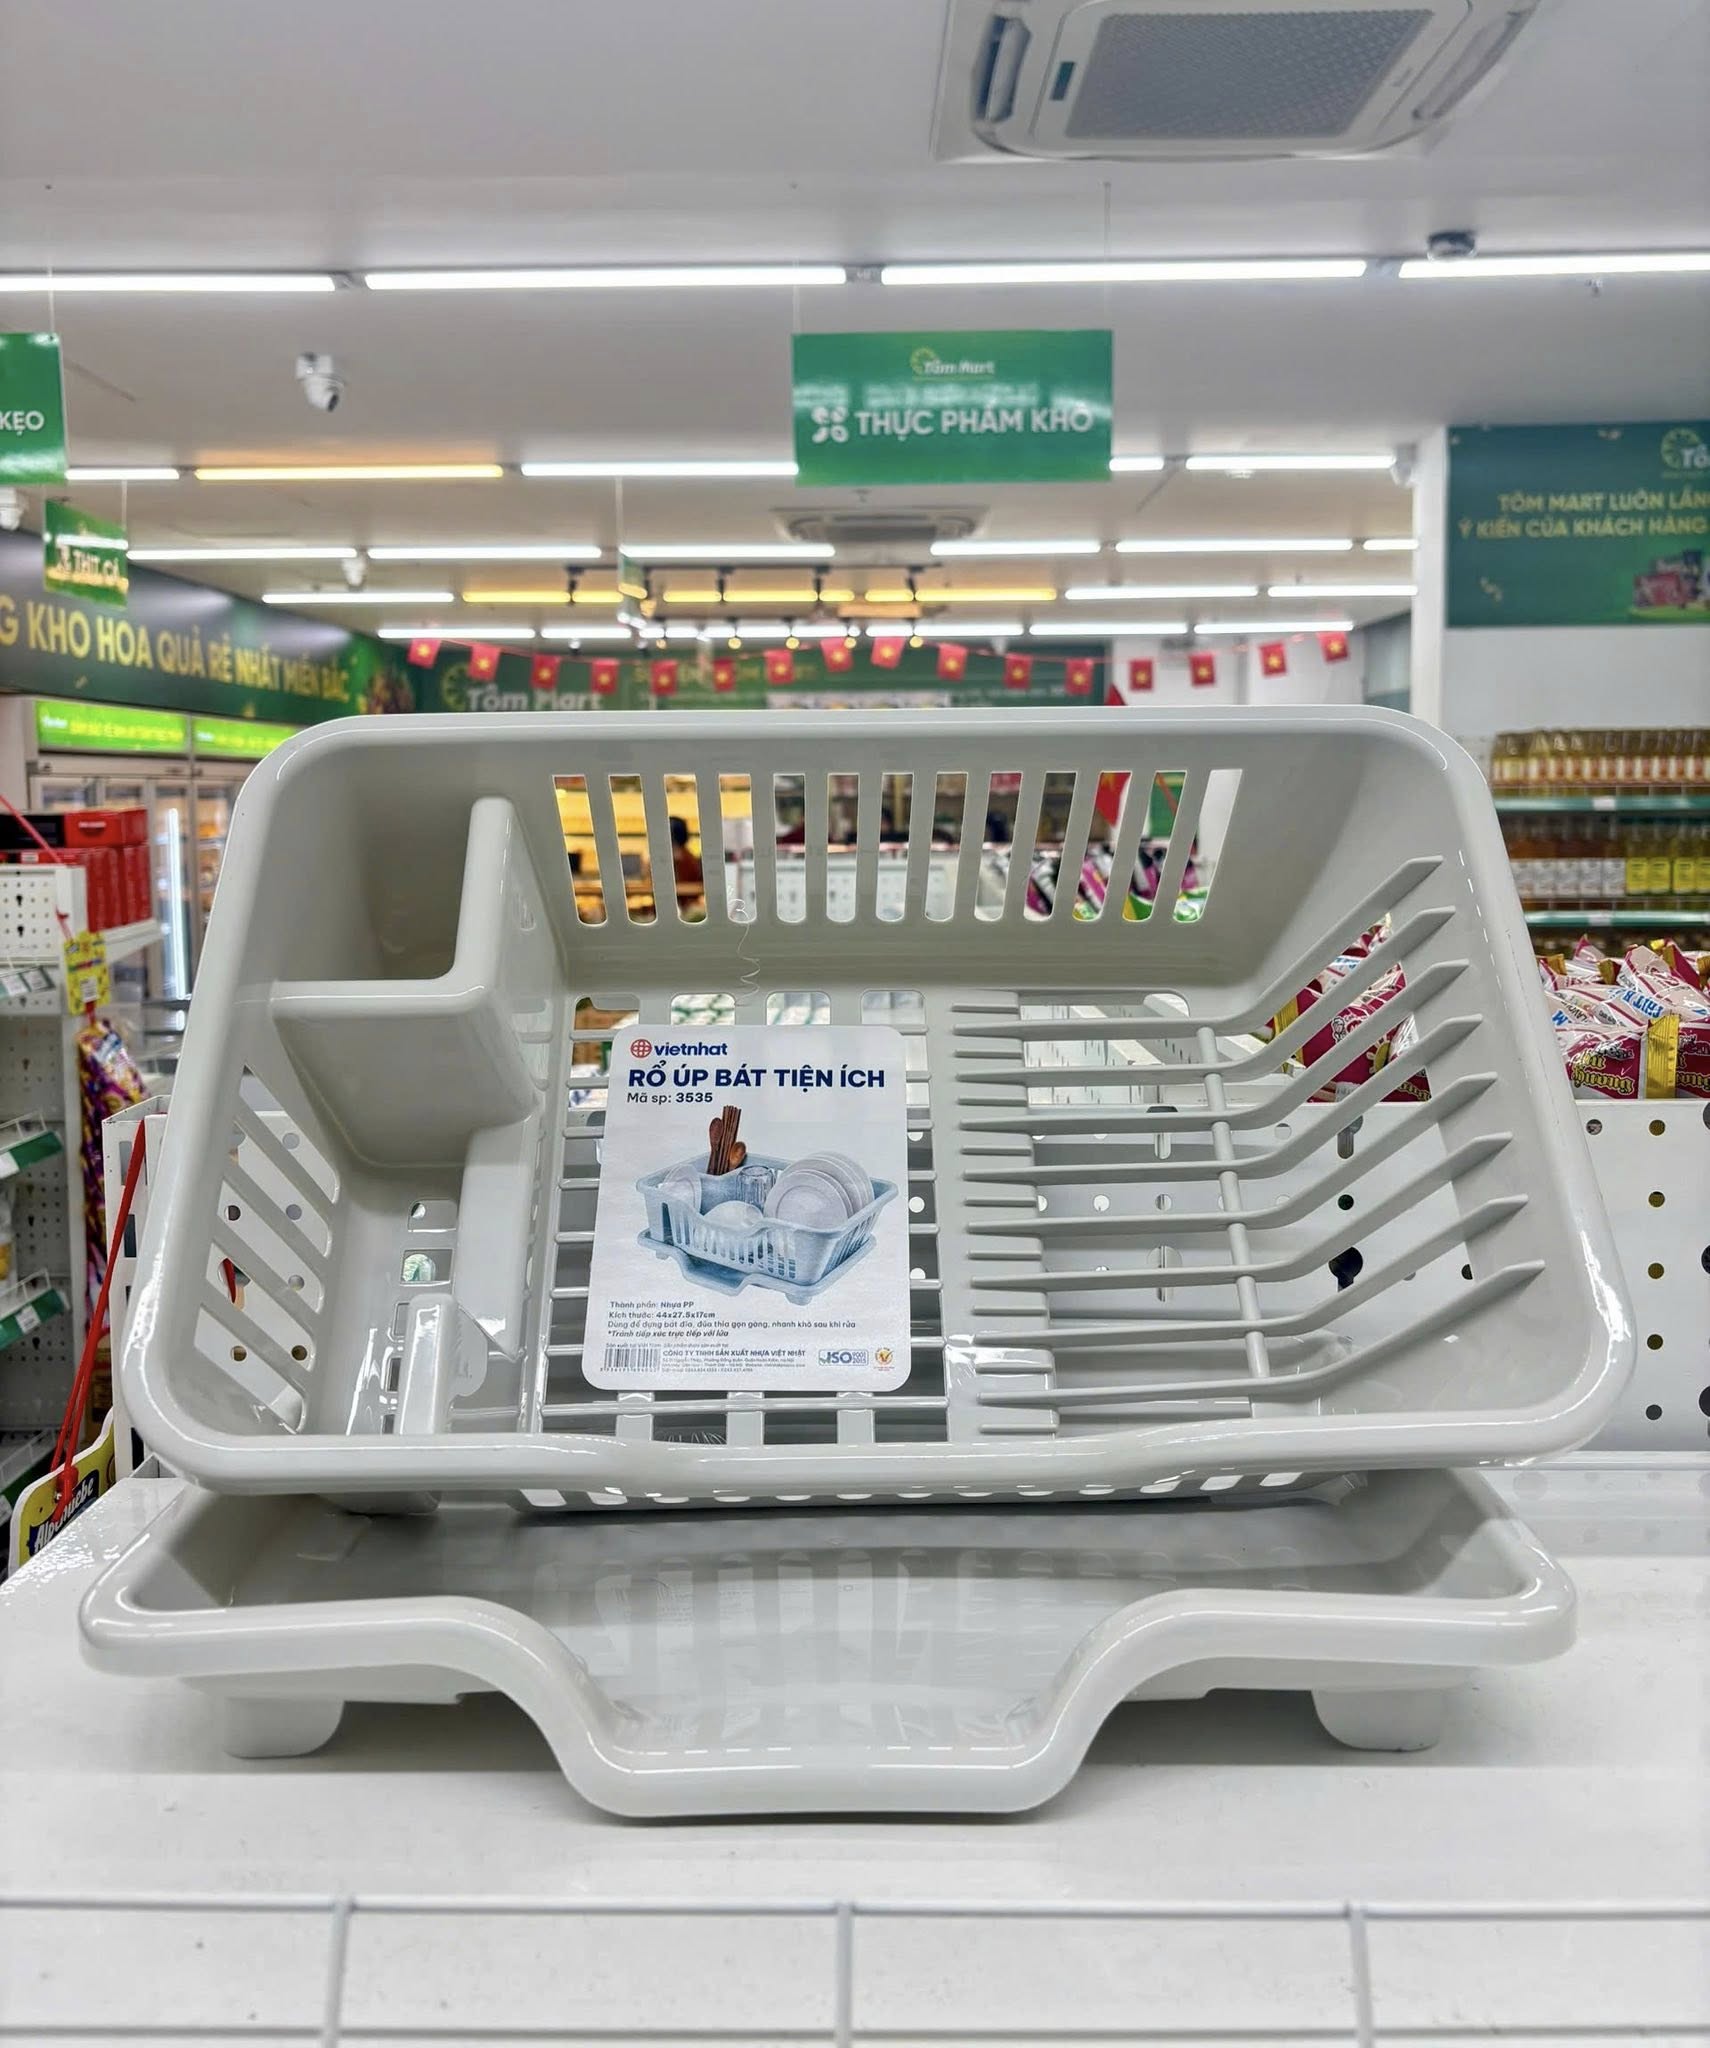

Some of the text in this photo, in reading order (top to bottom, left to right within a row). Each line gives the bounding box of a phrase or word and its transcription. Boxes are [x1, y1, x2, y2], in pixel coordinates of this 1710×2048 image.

[0, 410, 45, 436] KẸO
[855, 408, 934, 441] THỰC
[1031, 403, 1096, 433] KHÔ
[1498, 491, 1543, 513] TÔM
[1549, 492, 1604, 512] MART
[1608, 488, 1664, 512] LUÔN
[1573, 510, 1644, 537] KHÁCH
[26, 600, 92, 659] KHO
[96, 614, 154, 670] HOA
[157, 624, 206, 678] QUẢ
[207, 632, 233, 684] RẺ
[234, 641, 281, 692] NHẤT
[467, 683, 604, 712] Tôm Mart
[654, 1041, 728, 1056] vietnhat
[628, 1059, 885, 1093] RỔ ÚP BÁT TIỆN ÍCH
[627, 1092, 713, 1105] Mã sp: 3535
[683, 1300, 694, 1308] PP
[608, 1311, 627, 1319] Kích
[656, 1311, 716, 1319] 44x27.5x17cm
[731, 1321, 747, 1329] gọn
[772, 1320, 796, 1328] nhanh
[829, 1320, 841, 1328] khi
[663, 1349, 684, 1357] CÔNG
[685, 1349, 695, 1357] TY
[715, 1348, 730, 1357] SẢN
[730, 1348, 749, 1357] XUẤT
[750, 1349, 769, 1358] NHỰA
[770, 1348, 786, 1358] VIỆT
[826, 1351, 852, 1364] ISO
